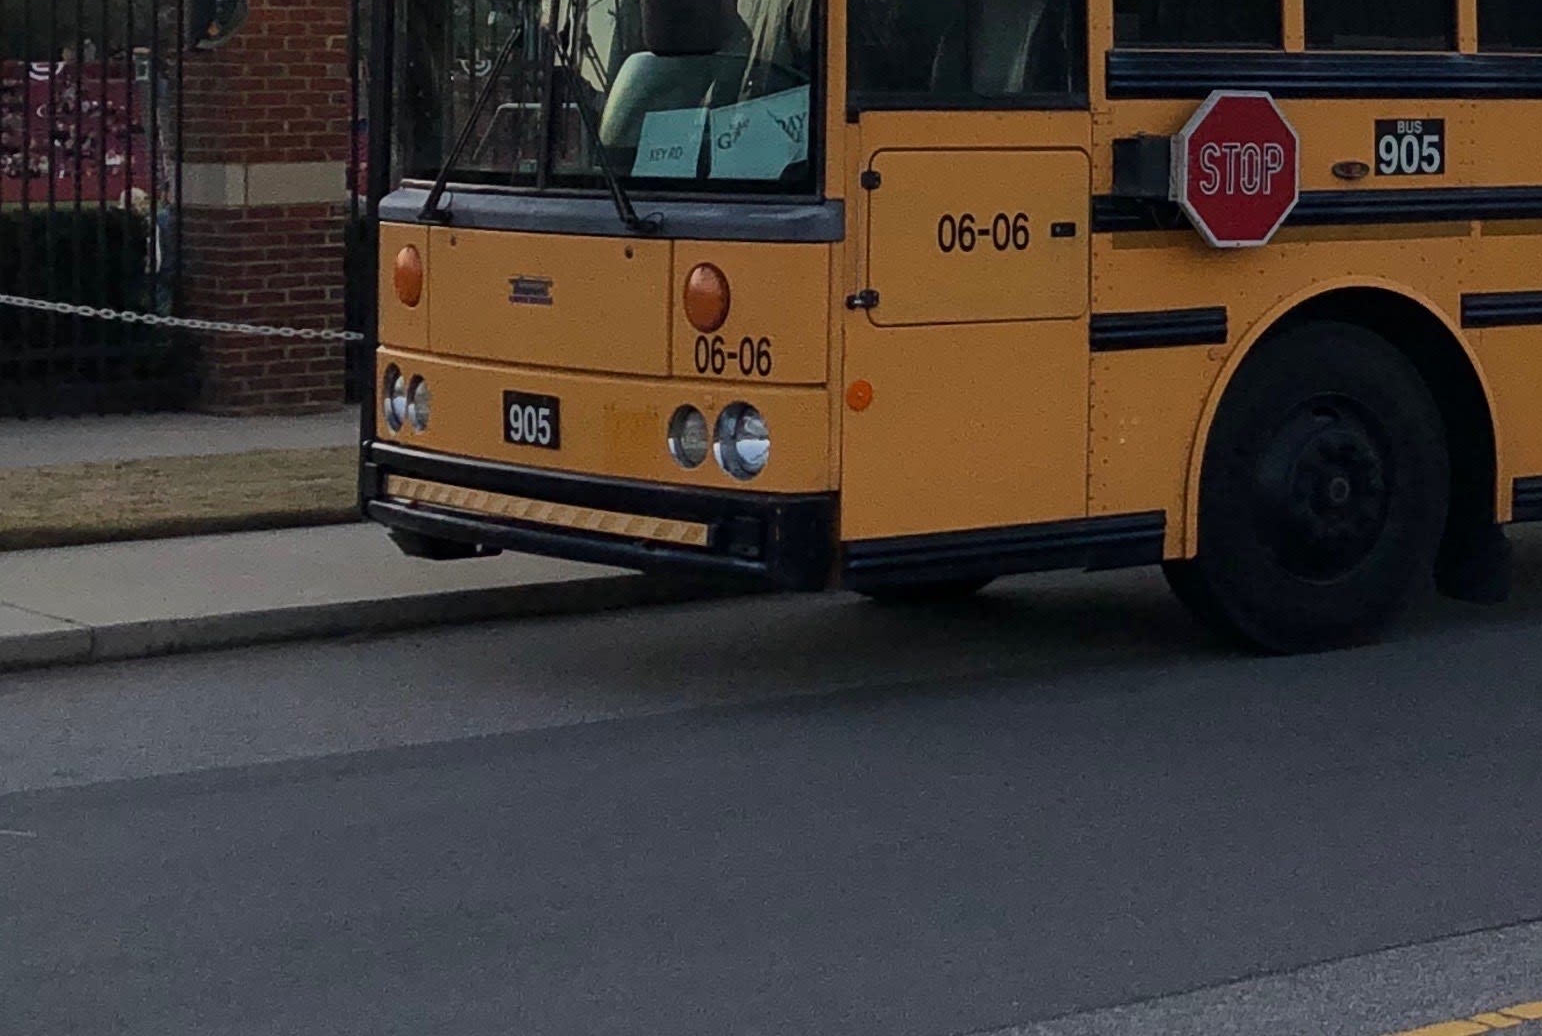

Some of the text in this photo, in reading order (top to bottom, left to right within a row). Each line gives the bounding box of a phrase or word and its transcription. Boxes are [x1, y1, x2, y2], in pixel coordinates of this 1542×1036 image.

[1396, 120, 1423, 134] BUS
[1200, 142, 1284, 196] STOP
[1378, 134, 1441, 174] 905
[937, 212, 1030, 253] 06-06
[694, 336, 773, 376] 06-06
[508, 404, 552, 446] 905
